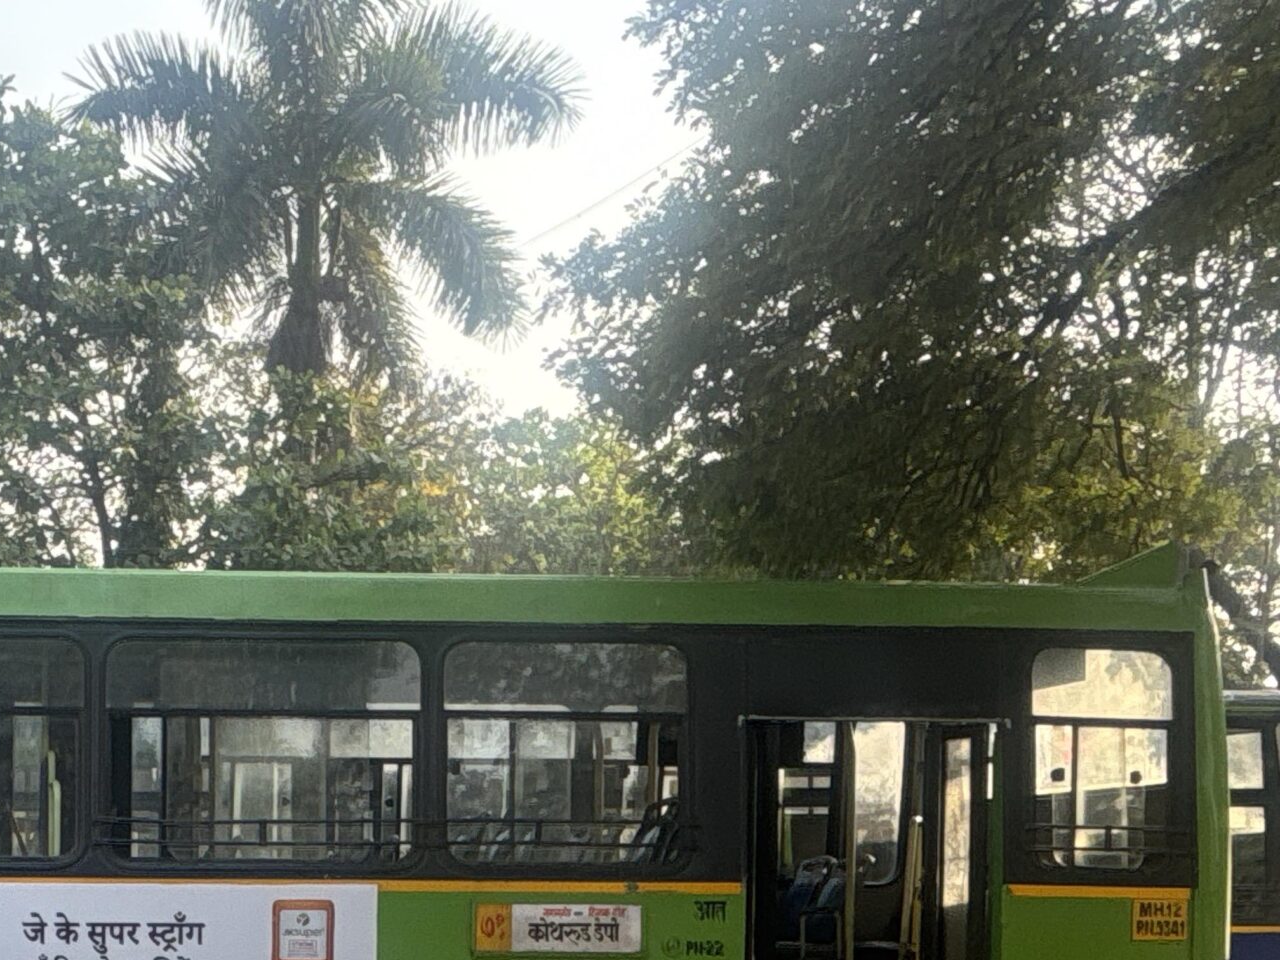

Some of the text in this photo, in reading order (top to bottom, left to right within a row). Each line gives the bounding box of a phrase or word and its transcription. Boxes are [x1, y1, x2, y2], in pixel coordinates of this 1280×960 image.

[694, 901, 727, 923] आत
[22, 912, 48, 945] जे
[54, 912, 80, 945] के
[85, 922, 140, 954] सुपर
[594, 917, 620, 942] डेपो
